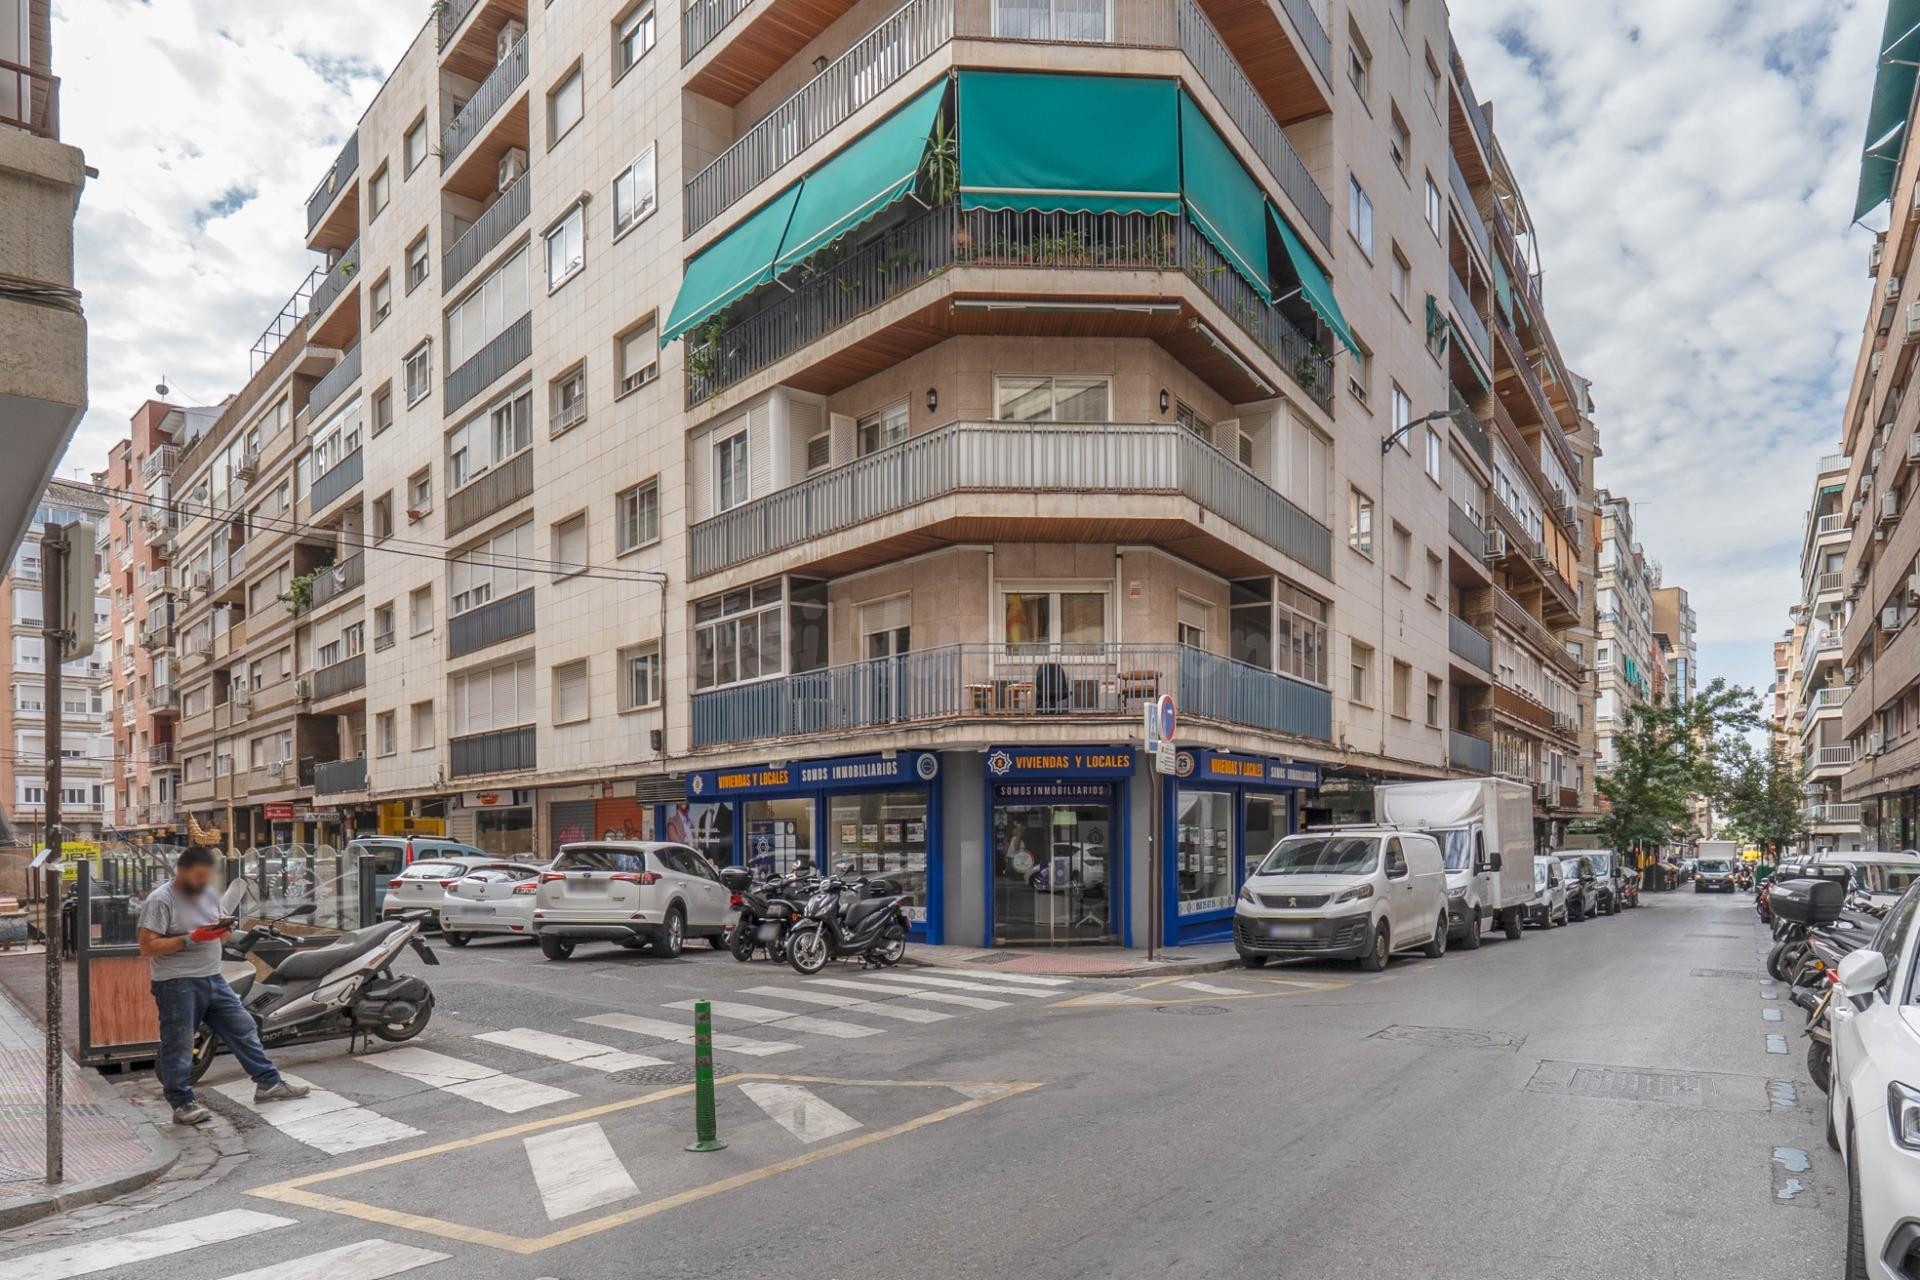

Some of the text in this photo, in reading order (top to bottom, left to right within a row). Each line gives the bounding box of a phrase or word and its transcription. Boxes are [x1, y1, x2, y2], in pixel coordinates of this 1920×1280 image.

[1016, 755, 1130, 769] VIVIENDAS Y LOCALES
[1178, 758, 1188, 768] 25
[801, 761, 898, 782] SOMOS INMOBILIARIOS
[718, 770, 789, 789] VIVIENDAS Y LOCALES
[1000, 785, 1104, 796] SOMOS INMOBILIARIOS
[262, 1025, 298, 1042] aprilia
